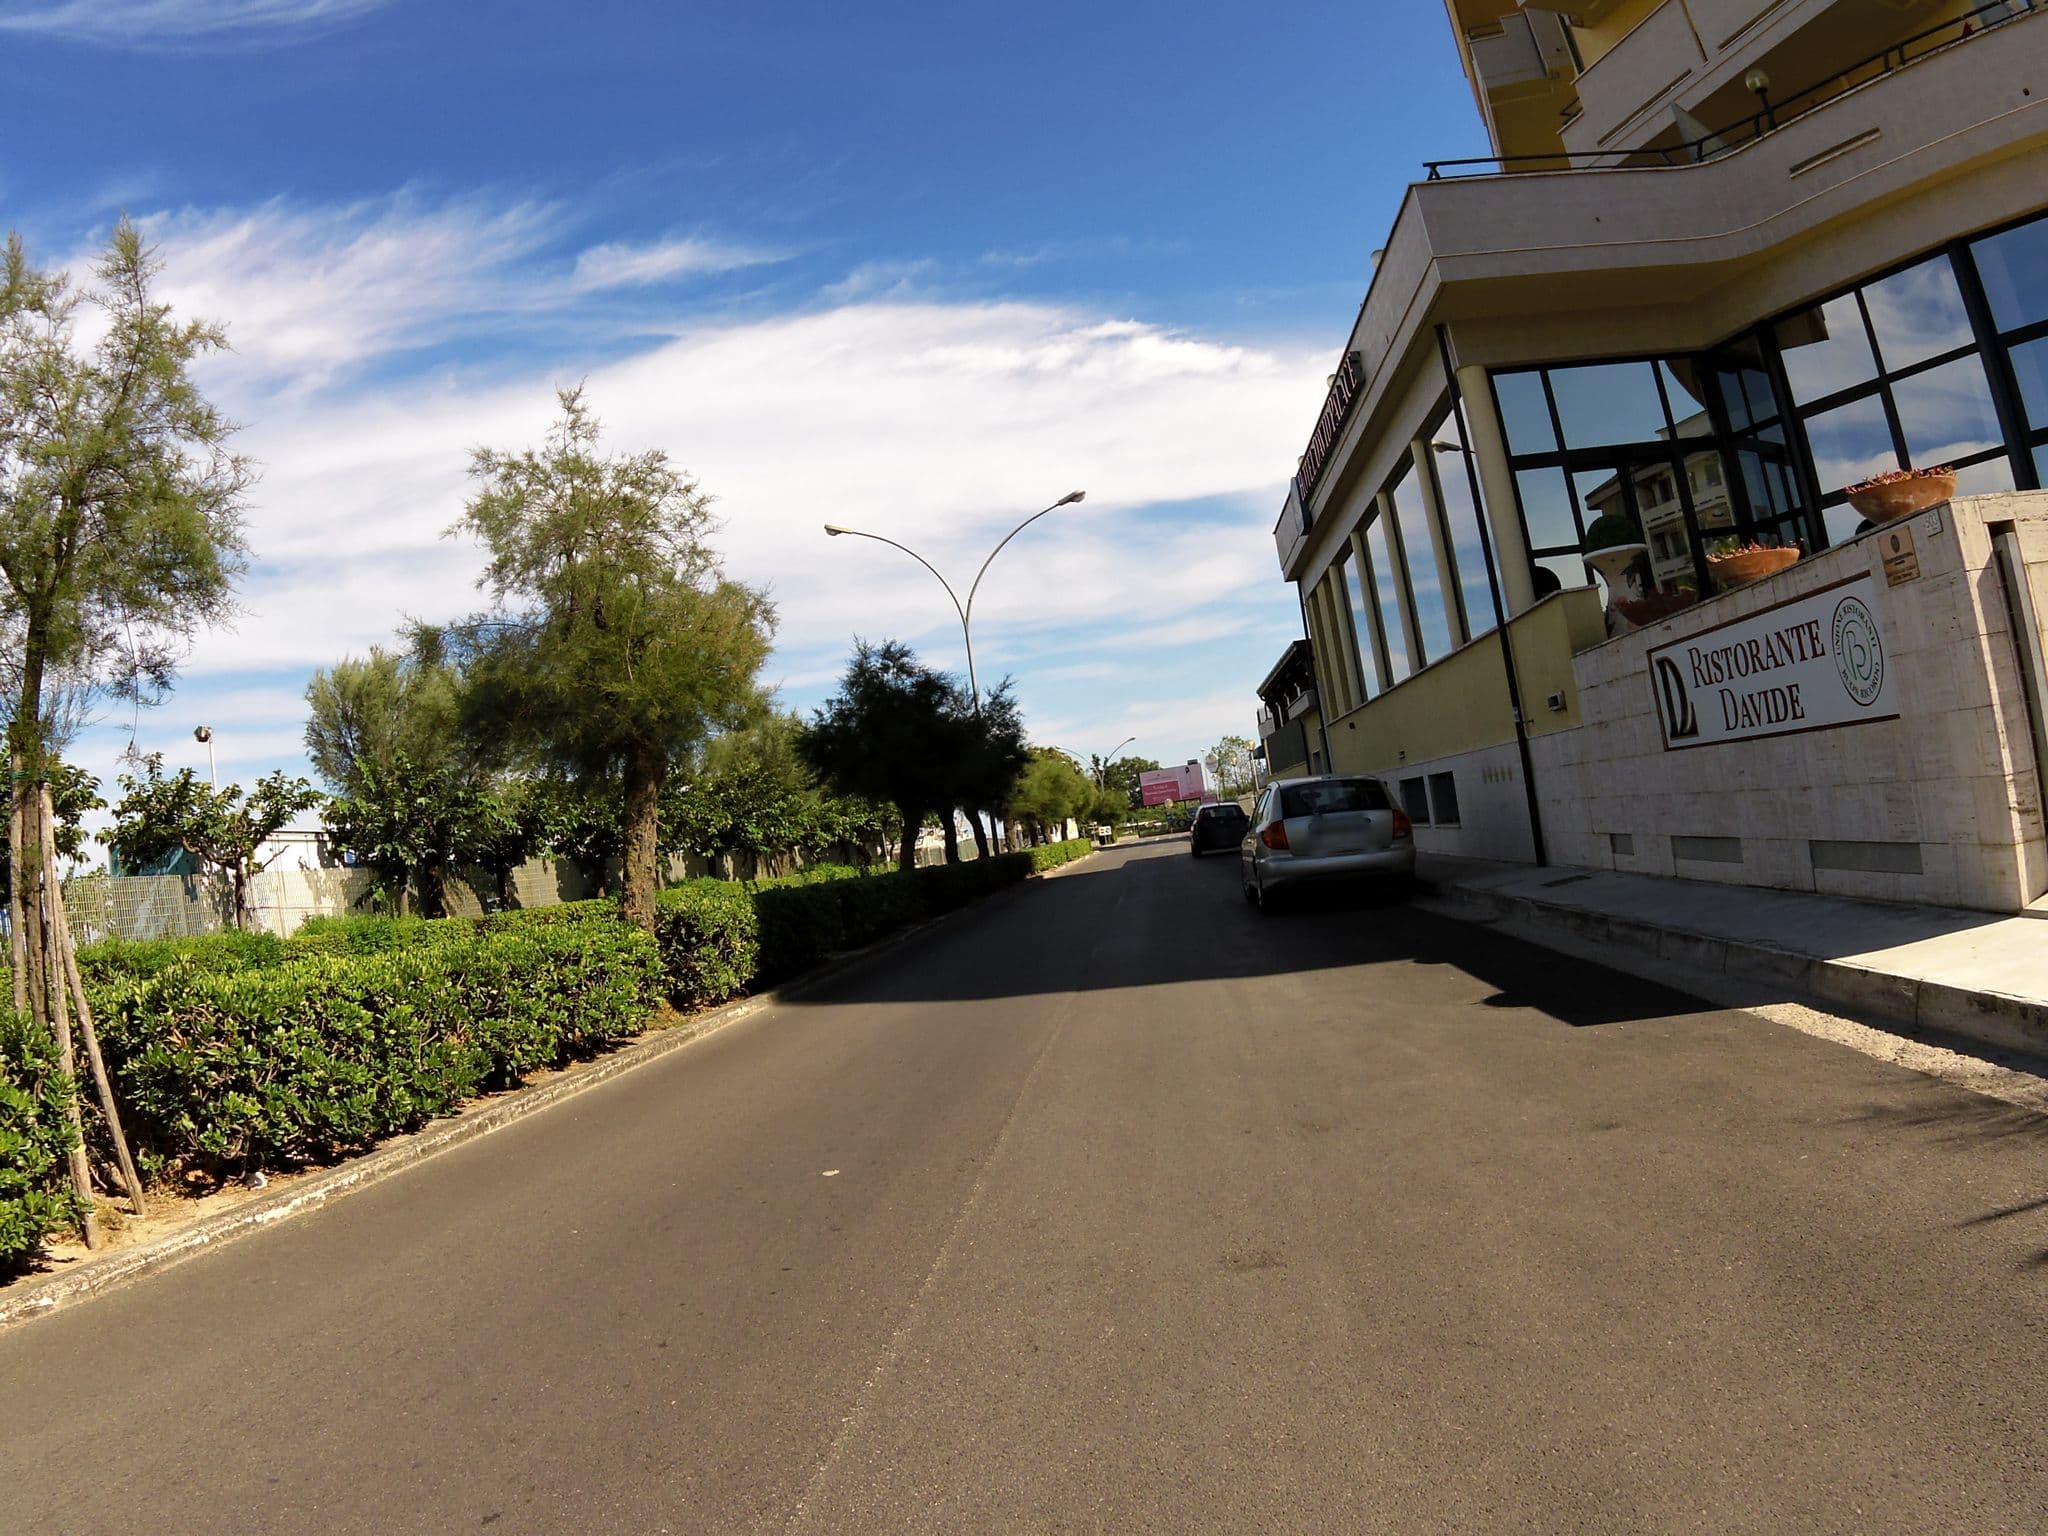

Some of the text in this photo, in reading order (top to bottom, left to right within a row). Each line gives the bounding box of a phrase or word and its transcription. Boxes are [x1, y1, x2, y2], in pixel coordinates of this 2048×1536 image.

[1328, 352, 1357, 421] PALACE
[1688, 619, 1825, 688] RISTORANTE
[1718, 683, 1805, 731] DAVIDE
